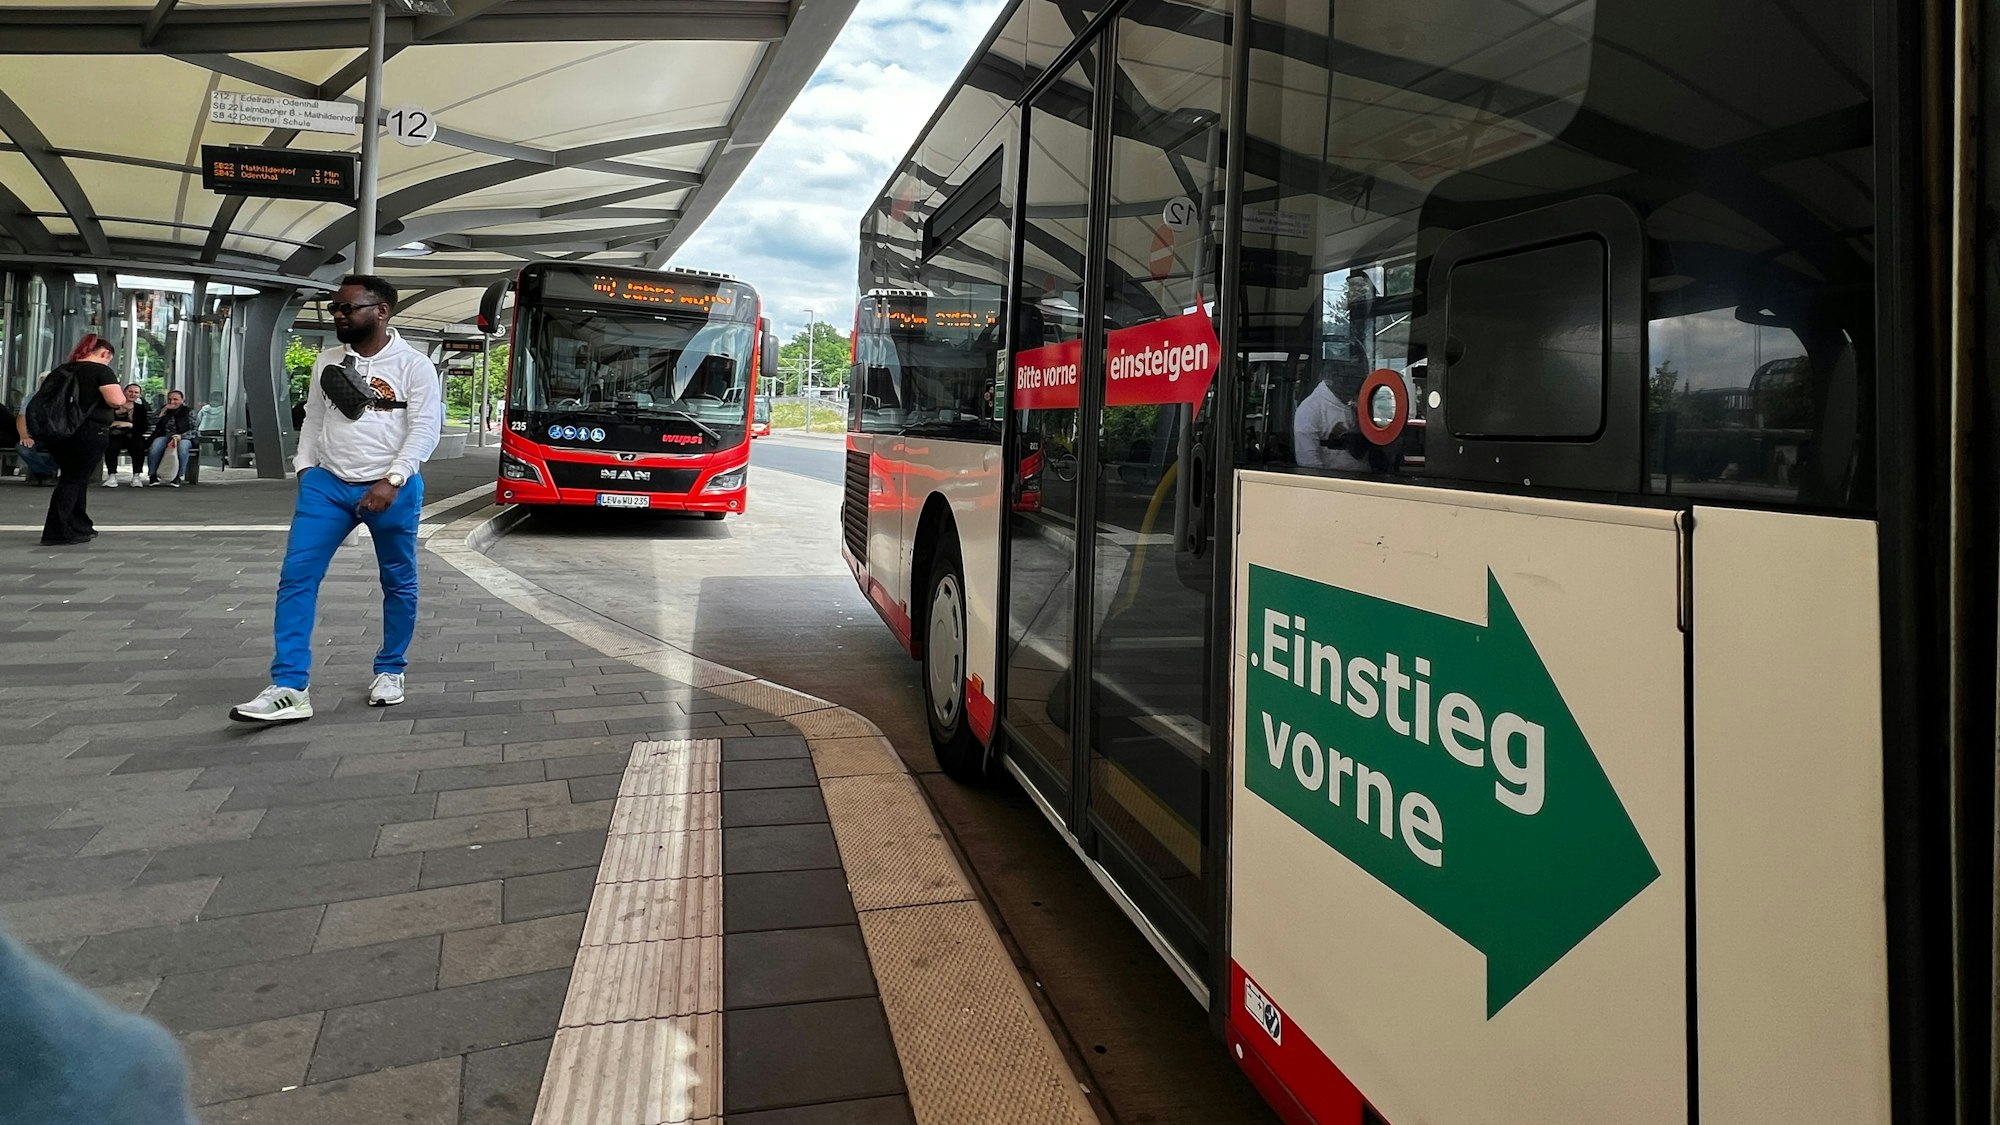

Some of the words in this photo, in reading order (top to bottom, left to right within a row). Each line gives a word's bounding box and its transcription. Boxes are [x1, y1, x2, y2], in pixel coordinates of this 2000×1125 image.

[240, 95, 274, 104] Edelrath
[282, 99, 318, 108] Odenthal
[240, 106, 287, 116] Leimbacher
[304, 112, 354, 122] Mathildenhof
[283, 118, 310, 127] Schule
[392, 110, 427, 138] 12
[214, 162, 234, 170] SB22
[241, 164, 296, 175] Mathildenhof
[241, 172, 278, 181] Odenthal
[1017, 367, 1040, 389] Bitte
[1043, 364, 1076, 387] vorne
[1110, 341, 1208, 381] einsteigen
[511, 421, 527, 430] 235
[662, 433, 702, 445] wupsi
[601, 469, 650, 481] MAN
[602, 495, 617, 504] LEV
[634, 497, 648, 505] 235
[1262, 711, 1443, 868] vorne
